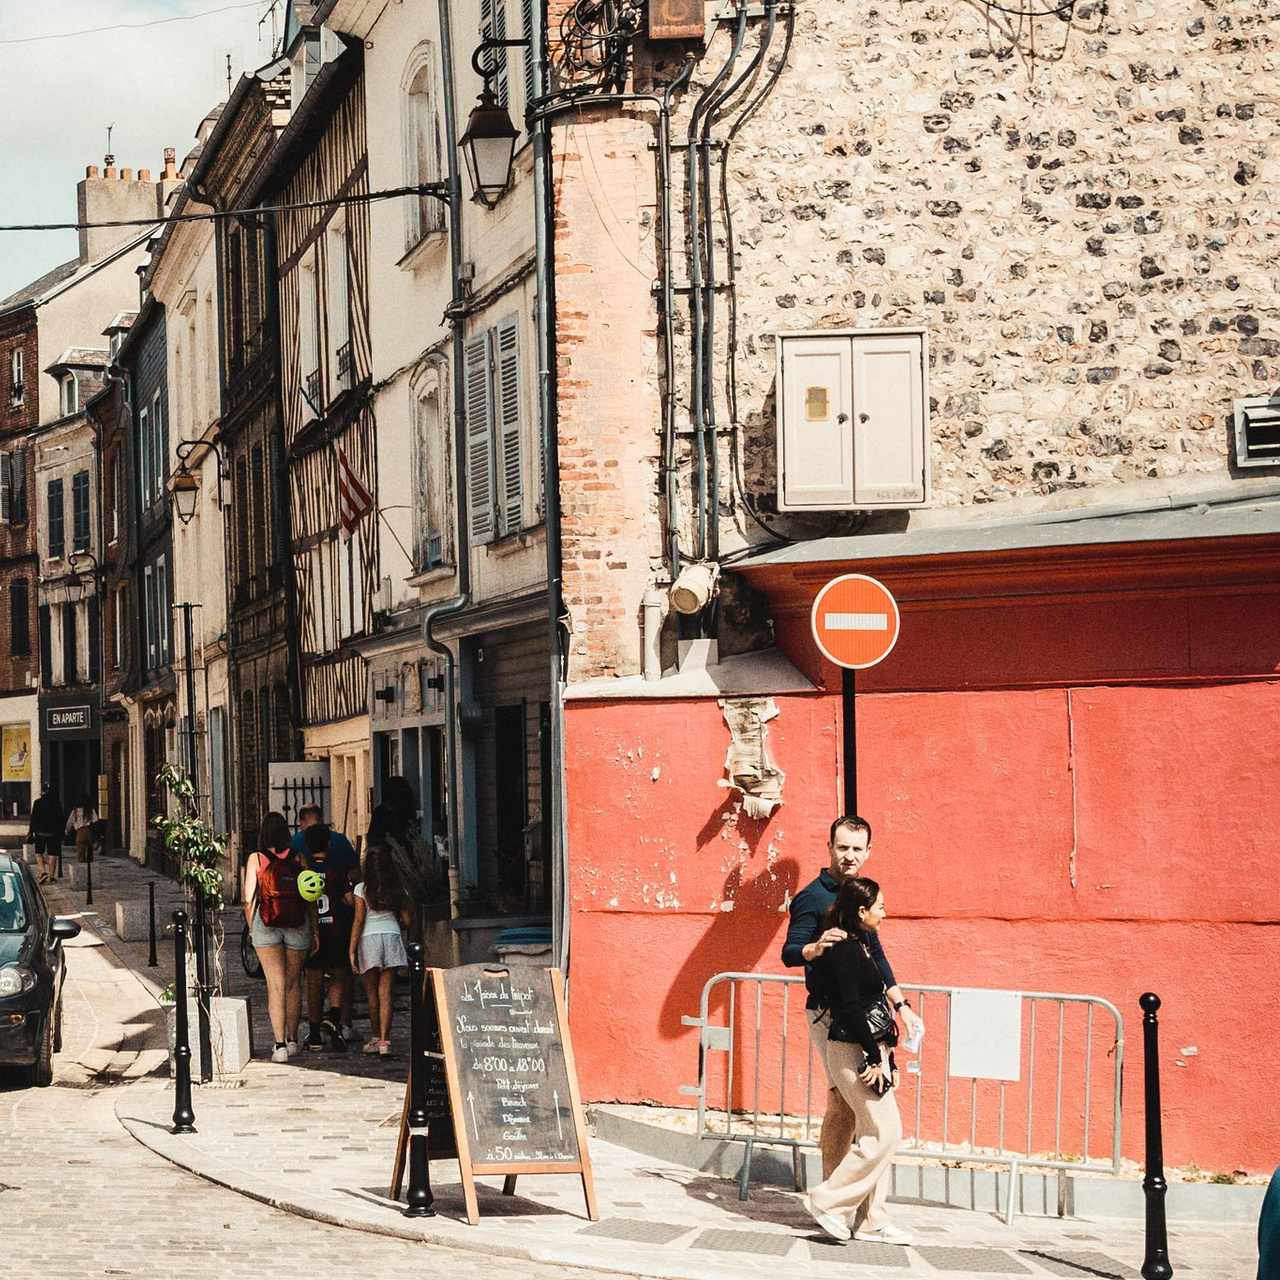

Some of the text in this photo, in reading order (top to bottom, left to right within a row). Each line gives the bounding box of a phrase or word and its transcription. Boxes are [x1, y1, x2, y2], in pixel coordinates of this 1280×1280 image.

[52, 711, 84, 725] EN APARTE
[480, 1024, 508, 1032] sommes
[495, 1146, 513, 1161] 50
